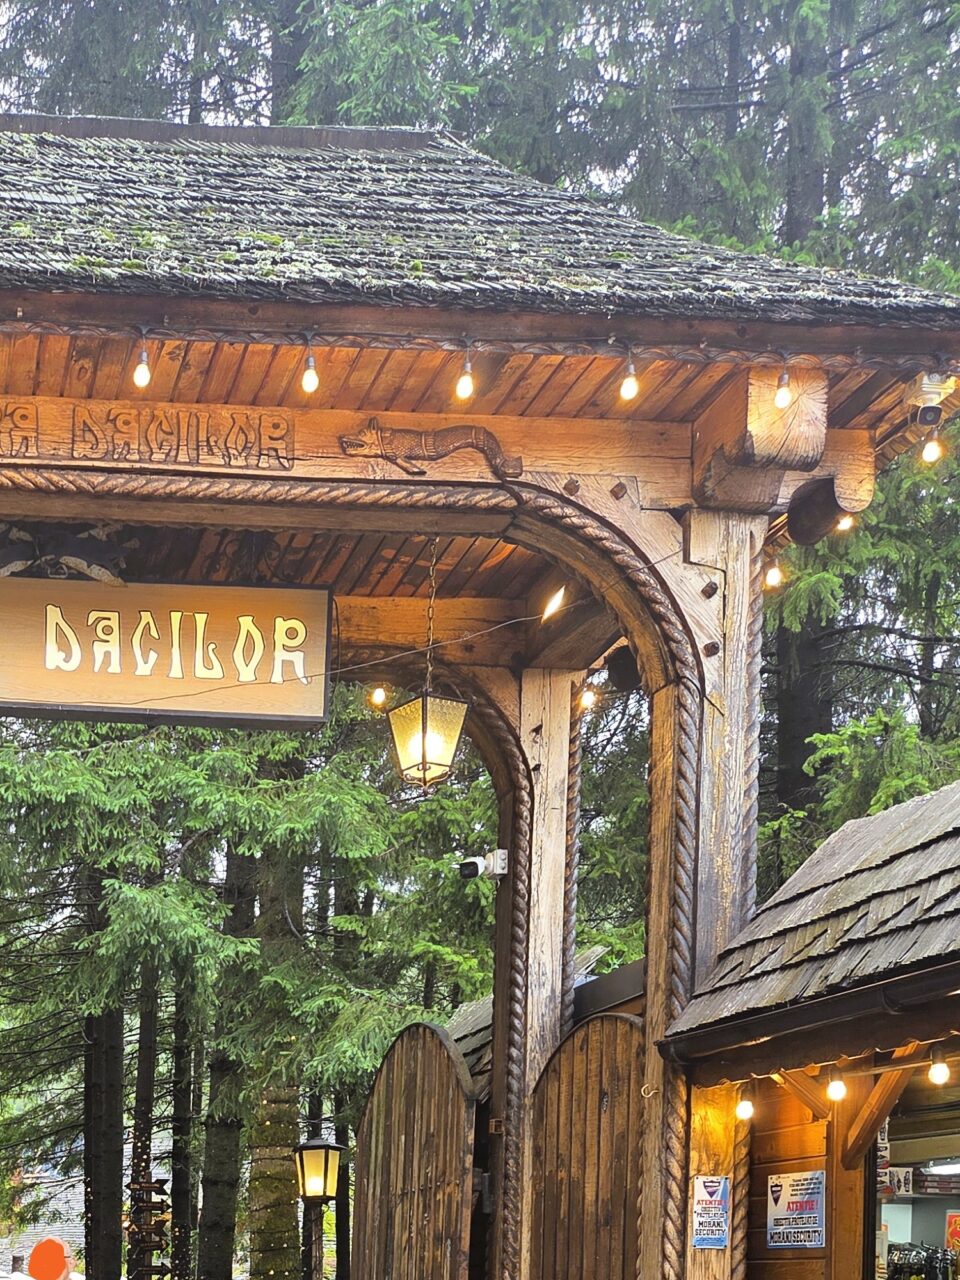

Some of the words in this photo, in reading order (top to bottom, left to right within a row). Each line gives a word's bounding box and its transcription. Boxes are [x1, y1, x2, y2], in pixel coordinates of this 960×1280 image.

[72, 405, 290, 469] DACILOR
[44, 603, 313, 686] DACILOR
[695, 1228, 726, 1236] SECURITY
[792, 1229, 822, 1243] SECURITY
